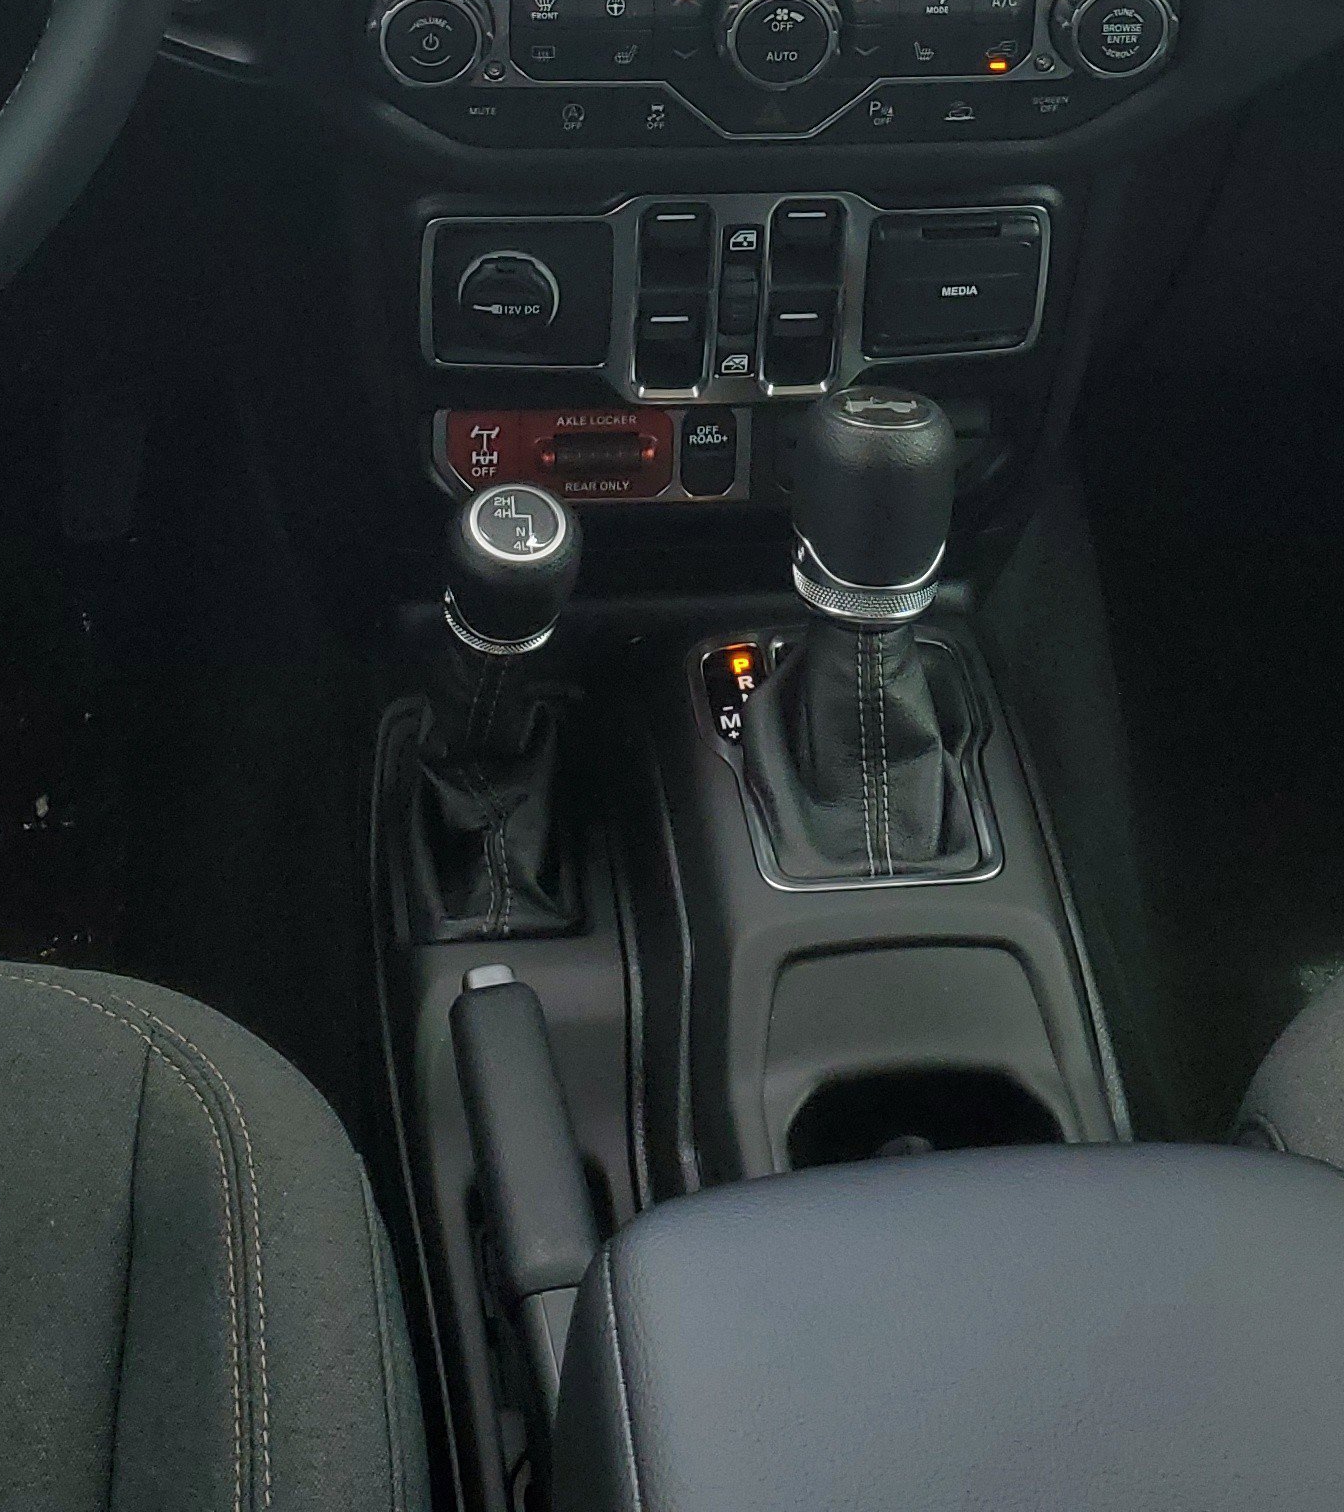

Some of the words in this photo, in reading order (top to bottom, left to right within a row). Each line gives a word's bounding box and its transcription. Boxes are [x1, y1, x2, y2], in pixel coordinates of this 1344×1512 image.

[531, 10, 559, 22] FRONT
[926, 4, 950, 16] MODE
[1112, 8, 1136, 20] TUNE
[770, 21, 795, 33] OFF
[1102, 22, 1143, 34] BROWSE
[1106, 33, 1138, 45] ENTER
[766, 50, 799, 63] AUTO
[646, 120, 666, 131] OFF
[941, 285, 979, 298] MEDIA
[502, 303, 523, 316] 12V
[523, 303, 541, 316] DC
[556, 414, 587, 428] AXLE
[589, 413, 637, 426] LOCKER
[696, 425, 720, 436] OFF
[688, 433, 729, 445] ROAD+
[472, 465, 498, 478] OFF
[564, 480, 599, 493] REAR
[600, 479, 631, 493] ONLY
[493, 496, 511, 506] 2H
[493, 508, 512, 519] 4H
[515, 526, 526, 537] N
[733, 658, 749, 674] P
[738, 675, 754, 690] R
[720, 714, 741, 730] M
